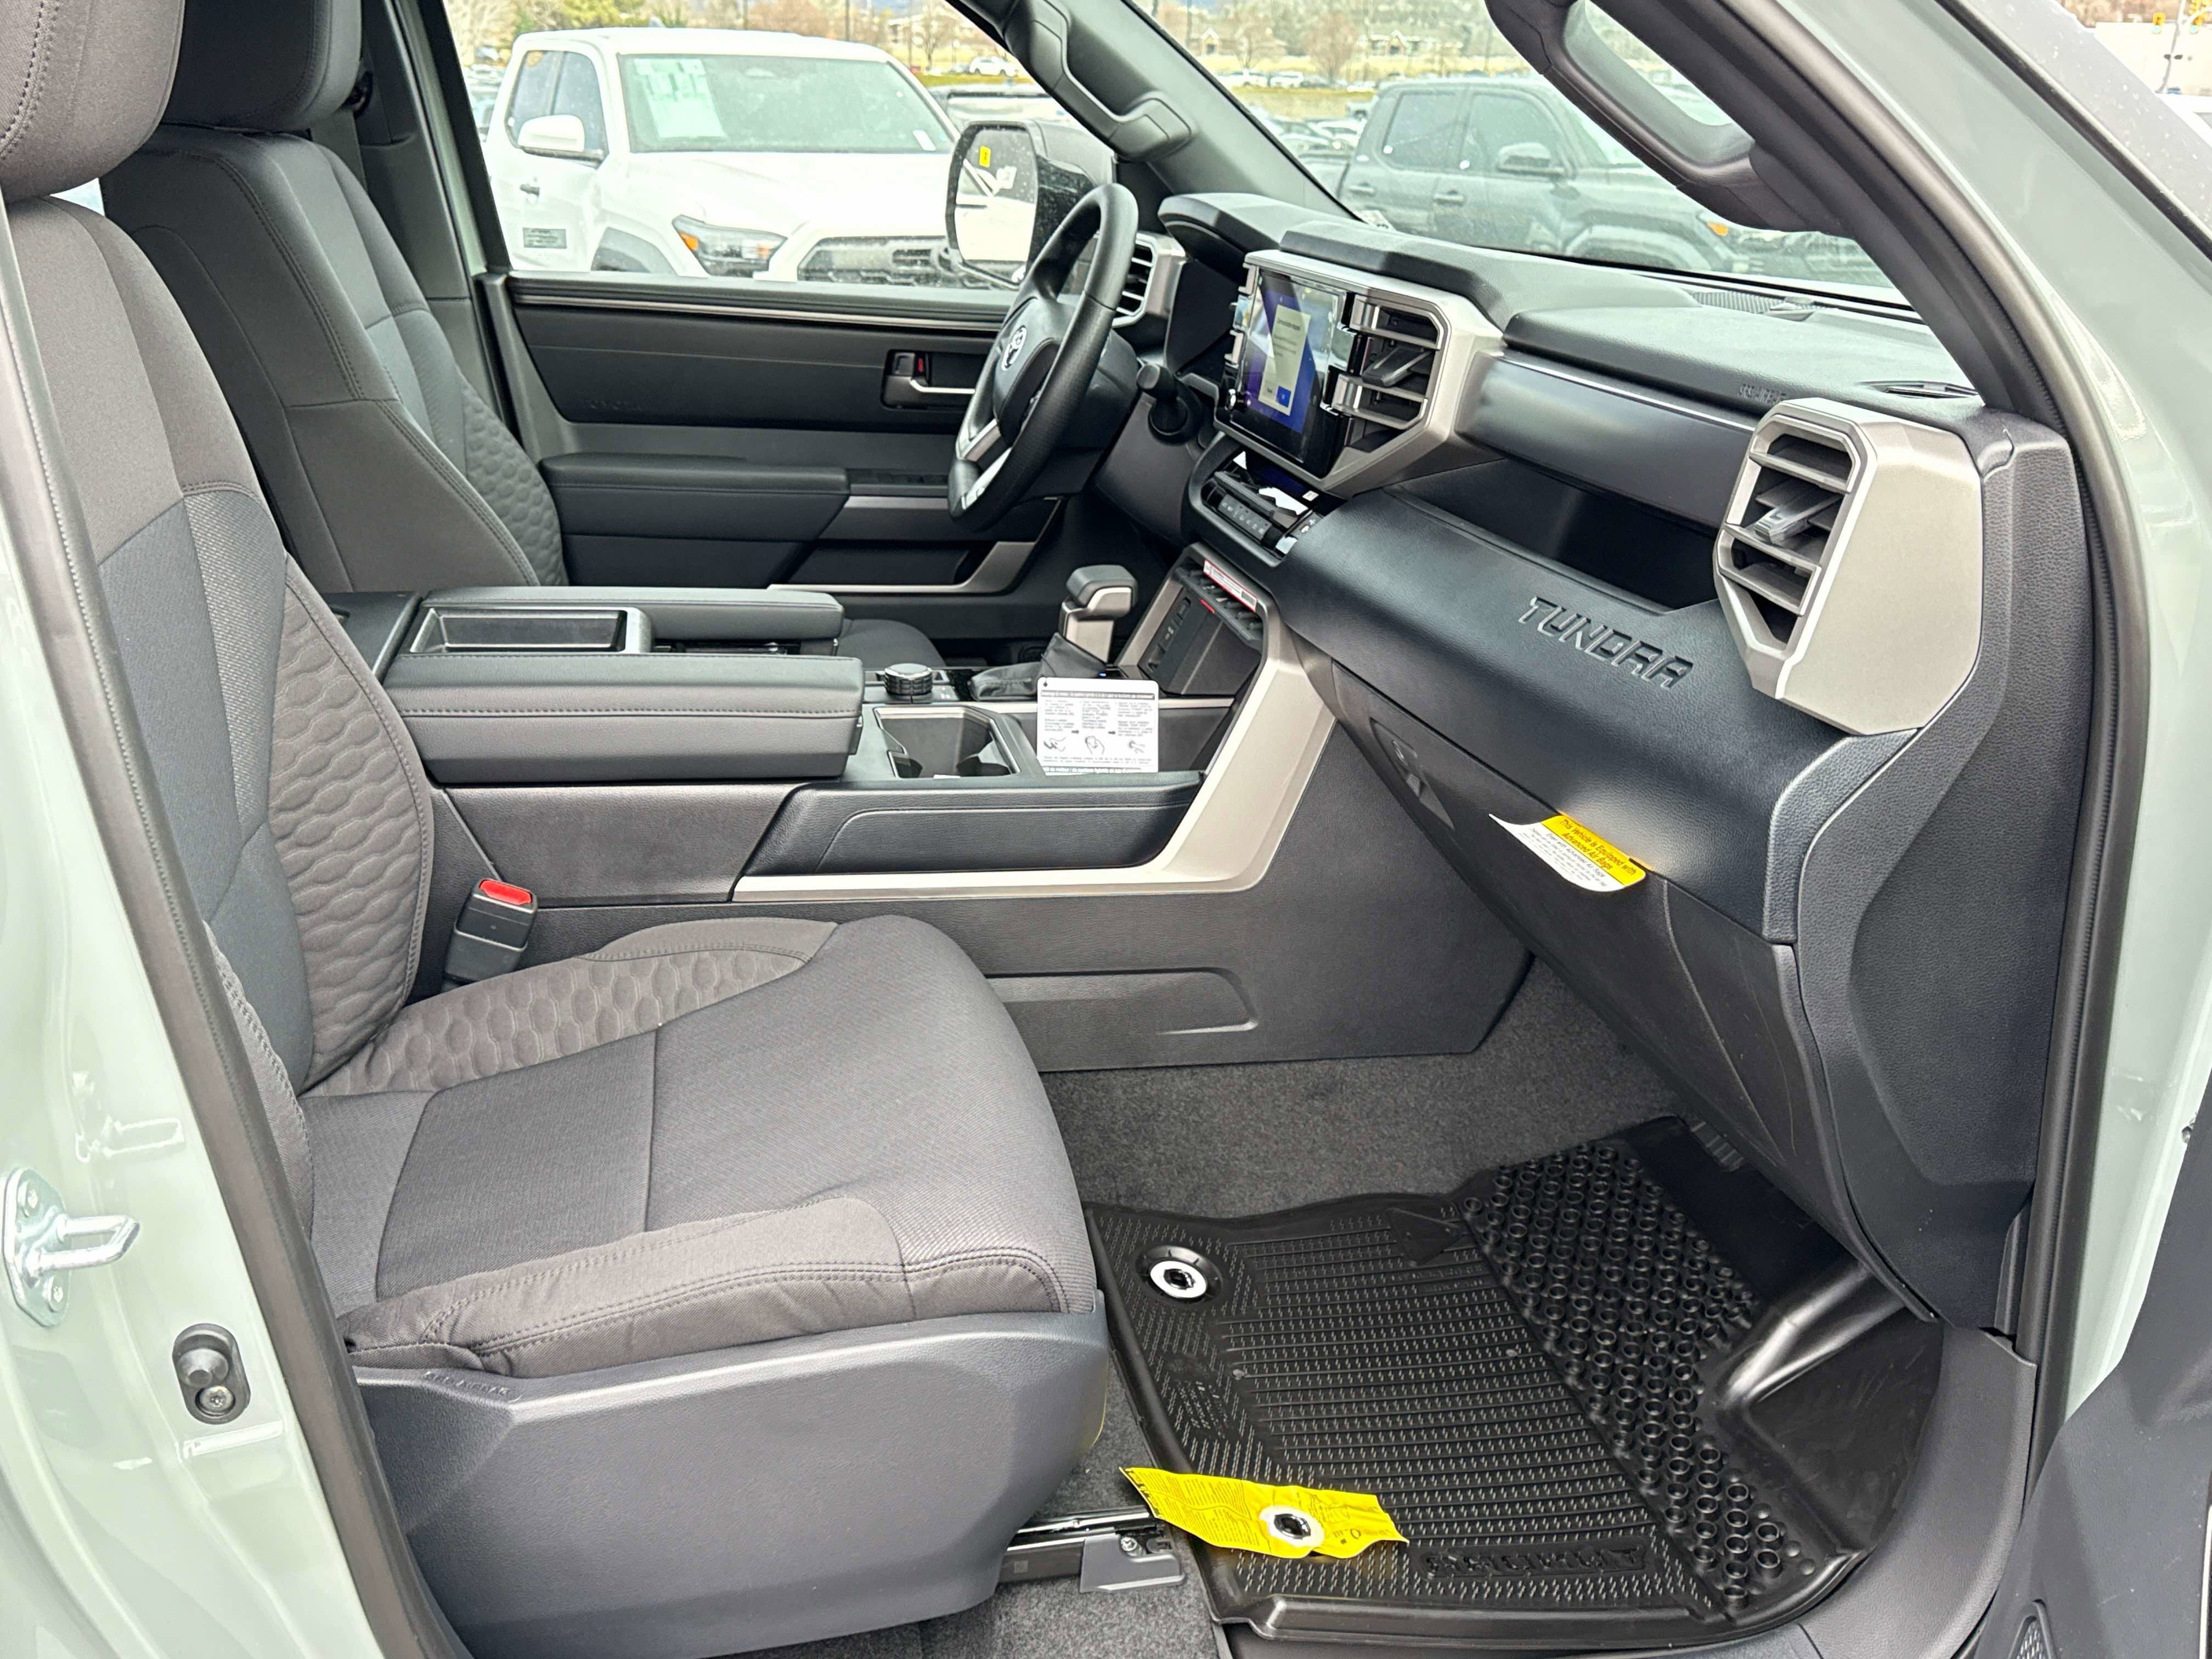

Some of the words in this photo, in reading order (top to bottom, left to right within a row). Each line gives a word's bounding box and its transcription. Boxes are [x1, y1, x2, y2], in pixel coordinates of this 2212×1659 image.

[1518, 596, 1693, 689] TUNDRA
[1560, 819, 1573, 830] This
[1572, 827, 1592, 843] Vehicle
[1595, 845, 1624, 866] Equipped
[1622, 864, 1637, 876] with
[1561, 833, 1591, 854] Advanced
[1588, 850, 1600, 859] Air
[1596, 857, 1613, 871] Bags
